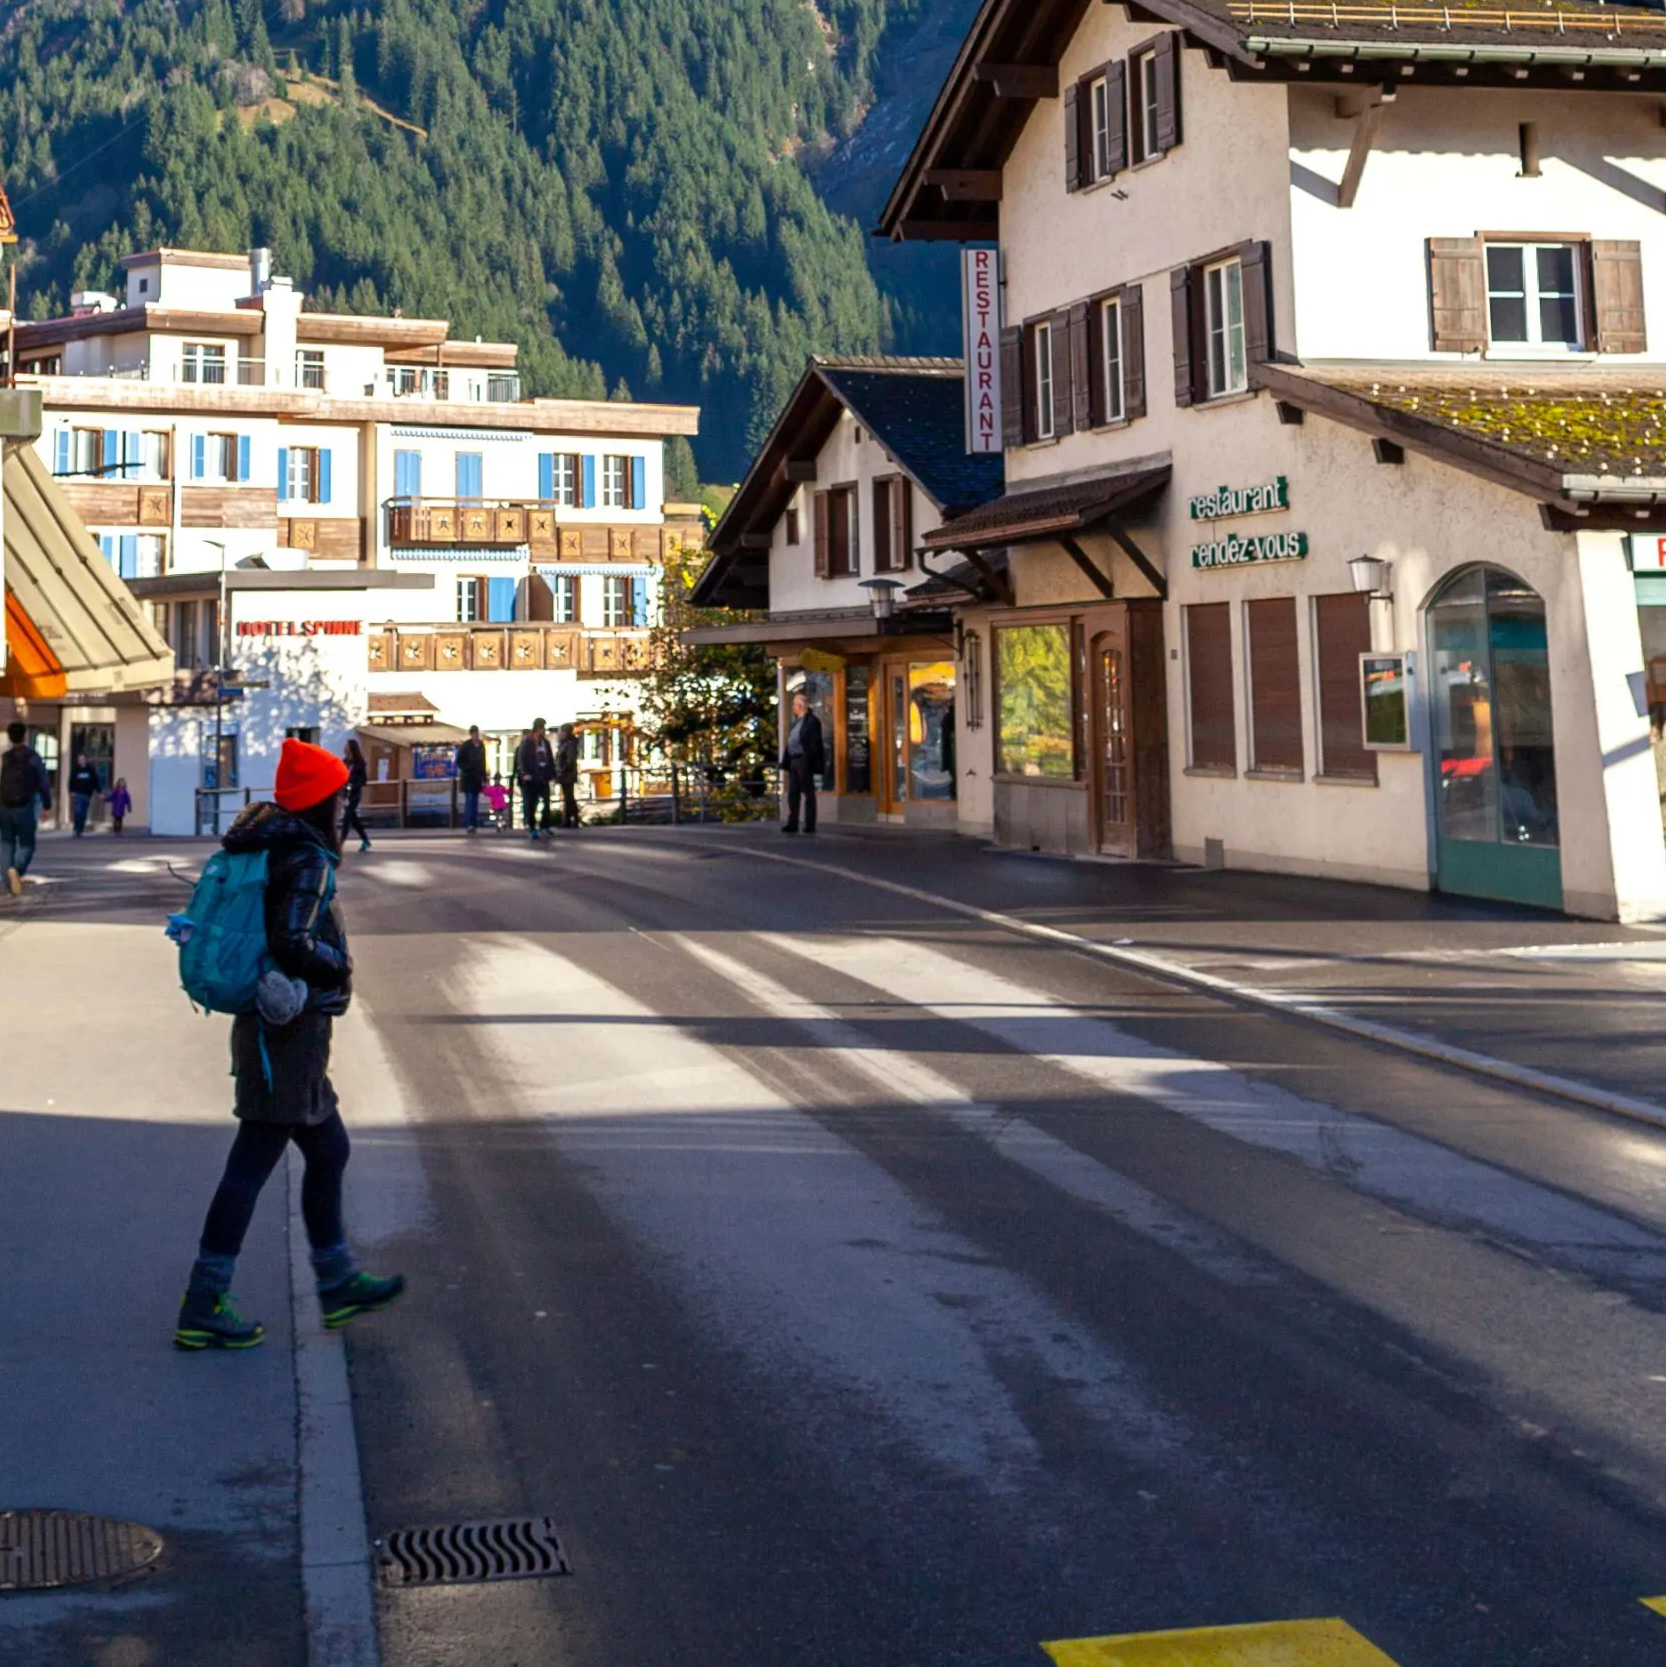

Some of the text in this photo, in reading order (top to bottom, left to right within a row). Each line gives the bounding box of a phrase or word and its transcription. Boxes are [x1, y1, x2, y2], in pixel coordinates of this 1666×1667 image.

[975, 250, 994, 452] RESTAURANT
[1189, 476, 1289, 519] restaurant
[1190, 532, 1307, 568] rendez-vous
[236, 620, 364, 636] HOTEL SPINNE
